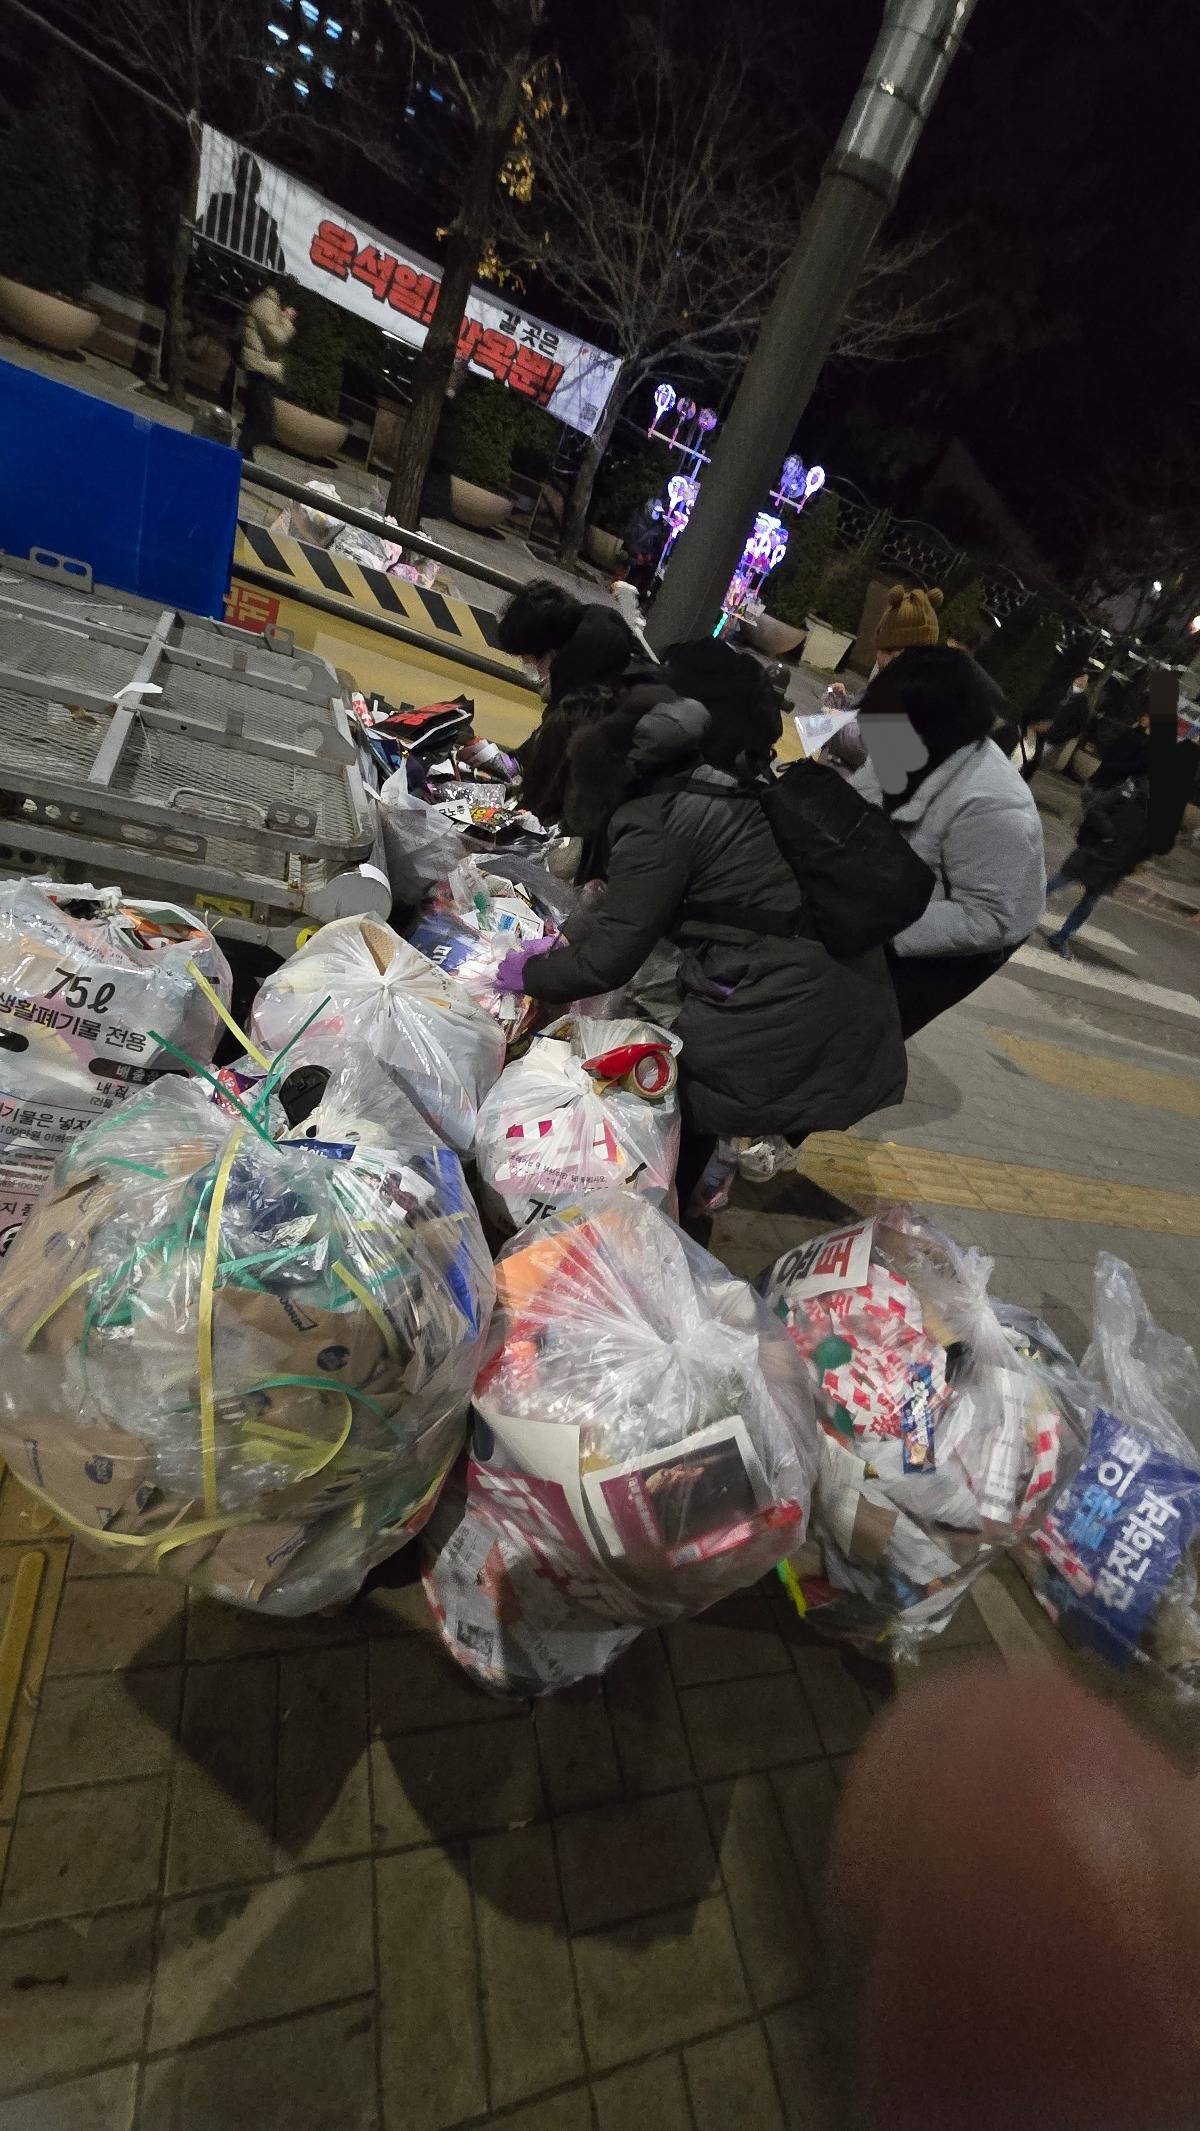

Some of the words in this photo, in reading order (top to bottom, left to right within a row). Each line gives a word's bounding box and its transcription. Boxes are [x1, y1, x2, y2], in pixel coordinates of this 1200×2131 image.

[498, 310, 521, 333] 갈
[522, 320, 560, 355] 곳은
[0, 991, 101, 1041] 생활폐기물
[105, 1026, 147, 1053] 전용
[0, 1102, 53, 1128] 기물은
[1093, 1489, 1182, 1613] 전진하라
